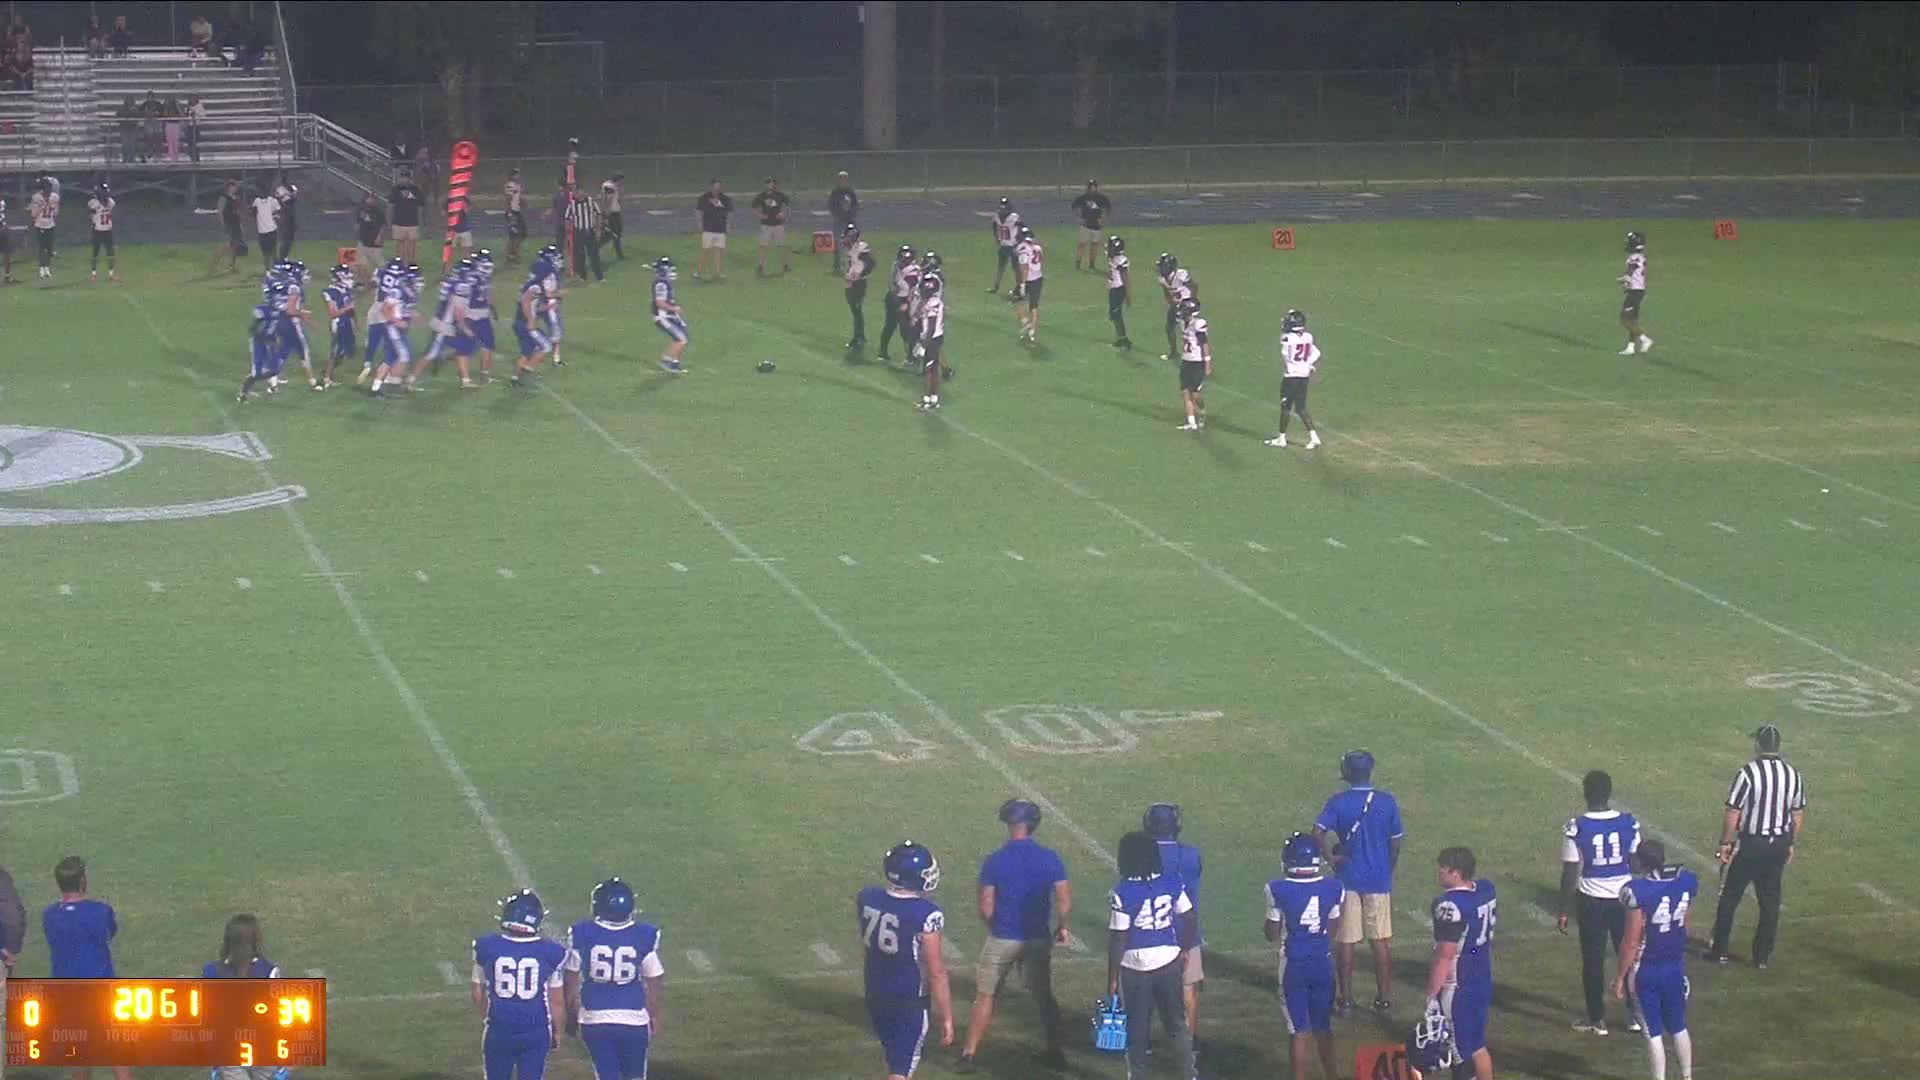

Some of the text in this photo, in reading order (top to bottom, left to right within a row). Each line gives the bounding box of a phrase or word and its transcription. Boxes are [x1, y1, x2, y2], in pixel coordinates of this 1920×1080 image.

[1275, 230, 1291, 245] 20
[1294, 343, 1311, 362] 21
[1592, 832, 1623, 866] 11
[863, 905, 899, 954] 76
[1134, 894, 1172, 930] 42
[1300, 896, 1321, 934] 4
[1652, 892, 1690, 933] 44
[494, 956, 540, 1000] 60
[590, 945, 637, 985] 66
